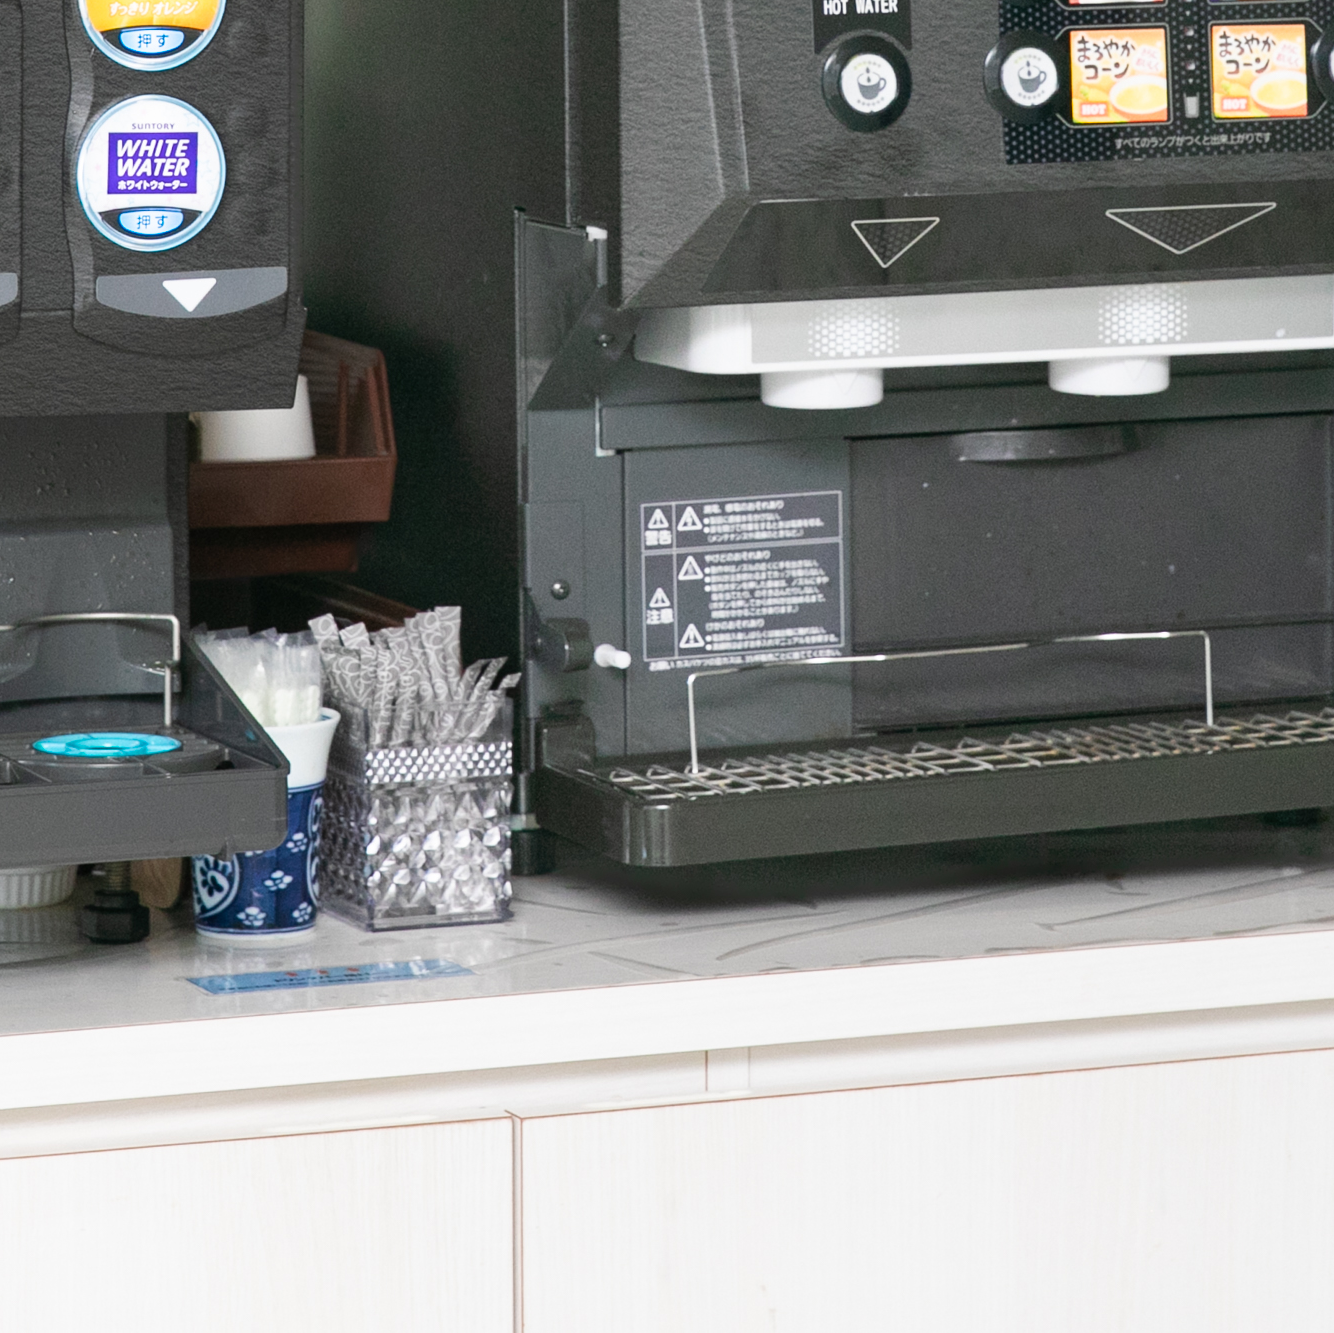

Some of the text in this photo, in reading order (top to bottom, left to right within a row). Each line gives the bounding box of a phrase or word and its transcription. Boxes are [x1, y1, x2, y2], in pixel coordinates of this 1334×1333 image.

[109, 1, 199, 17] すっきり オレンジ
[138, 34, 169, 48] 押す
[1219, 31, 1276, 58] まろやか
[1077, 36, 1136, 63] まろやか
[1084, 63, 1129, 80] コーン
[1226, 57, 1270, 75] コーン
[1081, 103, 1107, 116] HOT
[1223, 98, 1248, 111] HOT
[117, 139, 190, 157] WHITE
[117, 158, 190, 177] WATER
[117, 180, 188, 191] ホワイトウォーター
[136, 215, 168, 230] 押す
